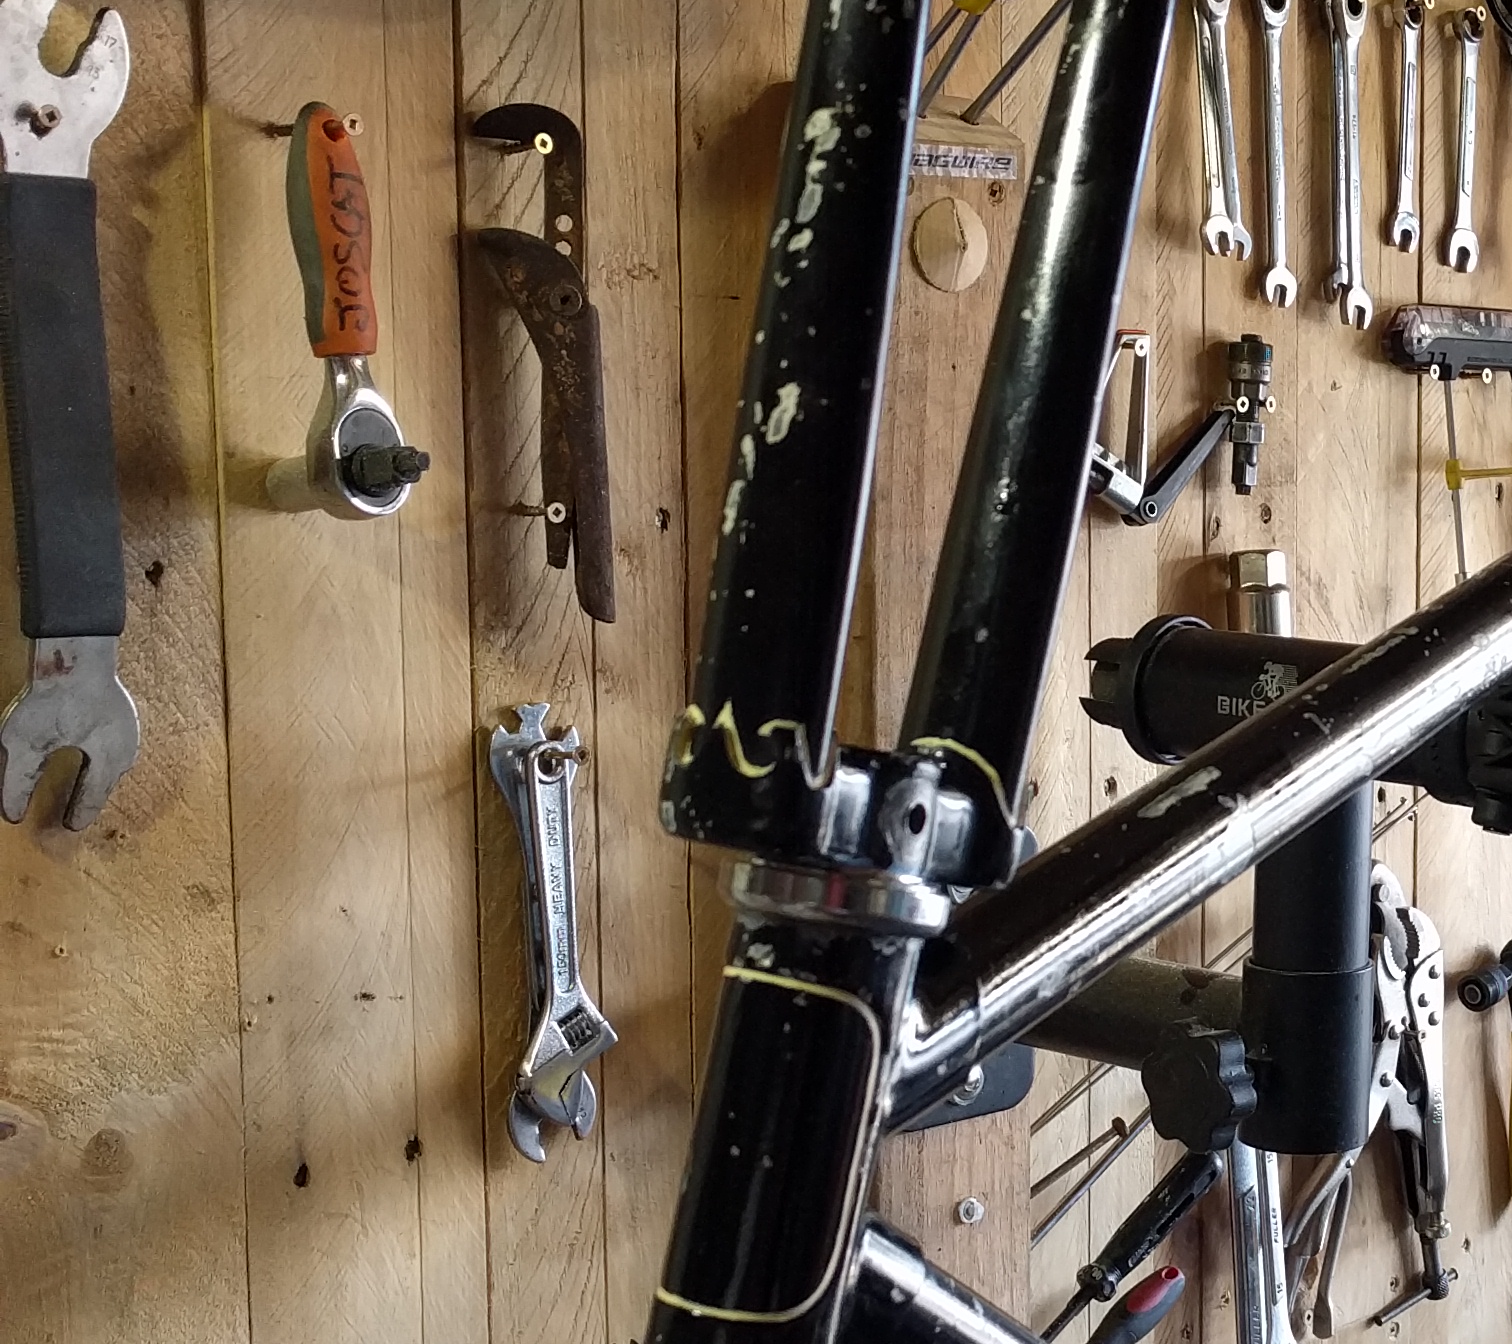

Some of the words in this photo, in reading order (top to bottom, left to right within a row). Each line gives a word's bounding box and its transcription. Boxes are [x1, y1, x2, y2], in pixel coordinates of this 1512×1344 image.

[546, 805, 560, 847] DUTY
[550, 862, 565, 916] HEAVY
[1271, 1207, 1279, 1243] FULLER
